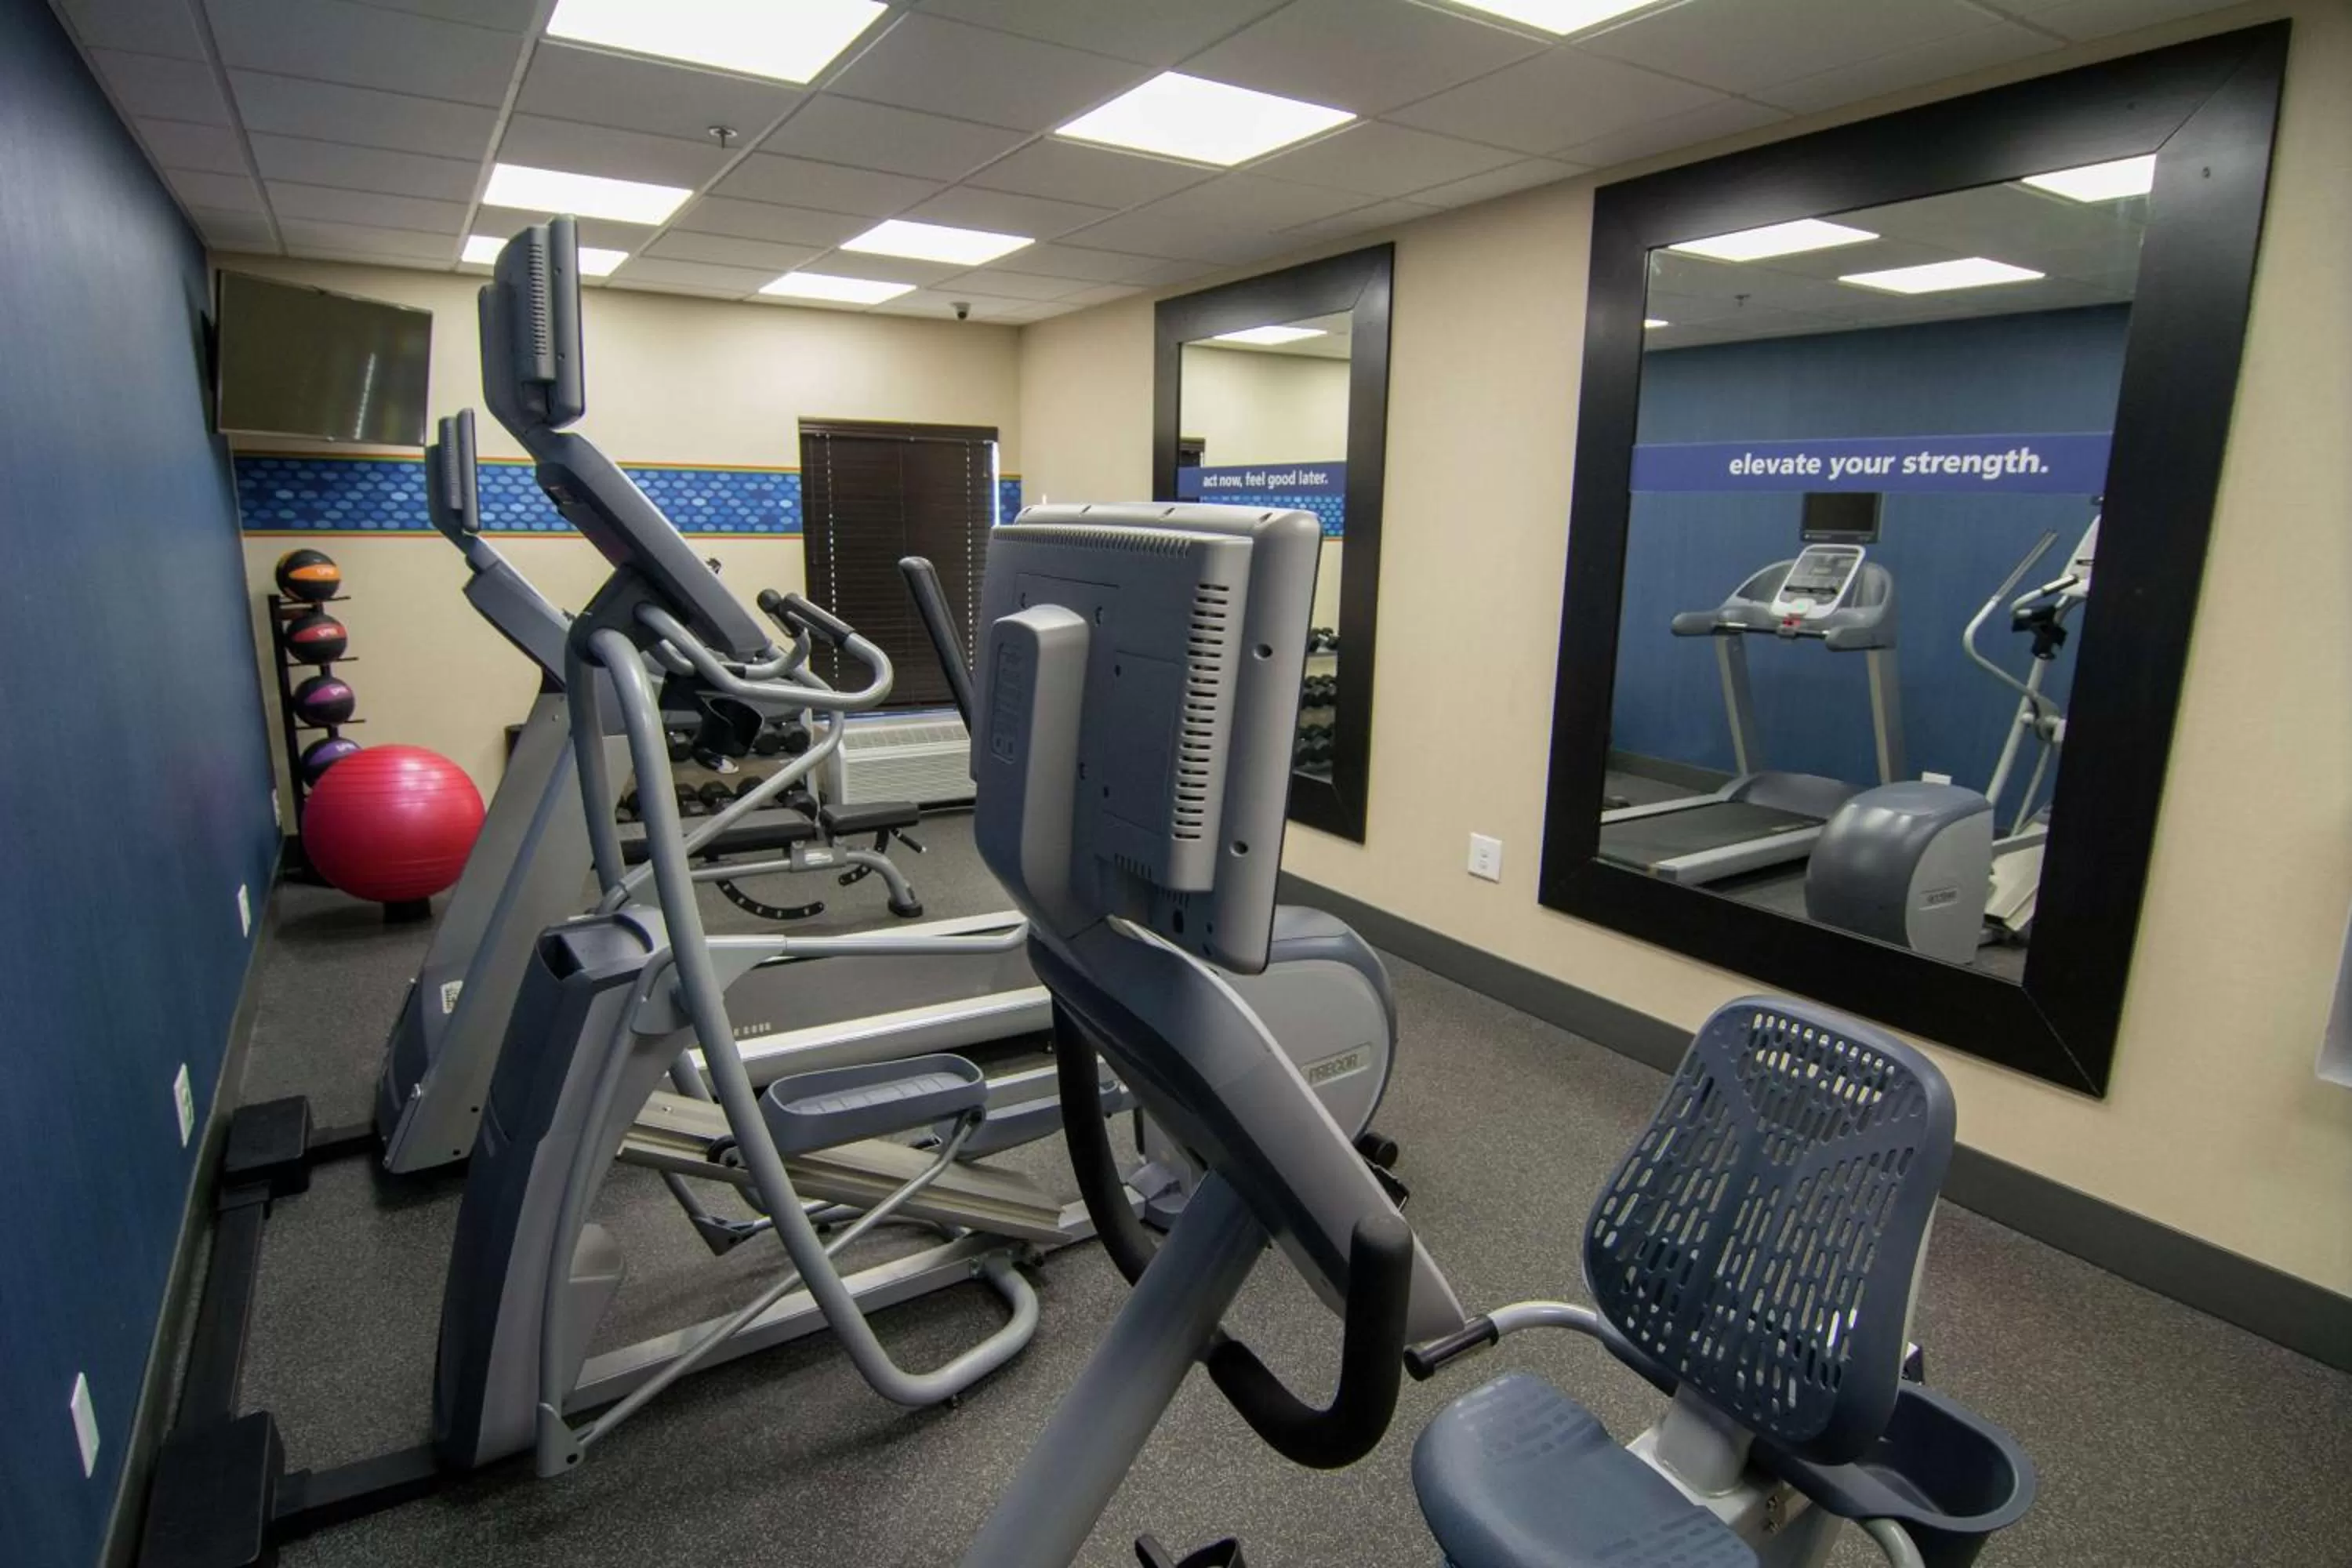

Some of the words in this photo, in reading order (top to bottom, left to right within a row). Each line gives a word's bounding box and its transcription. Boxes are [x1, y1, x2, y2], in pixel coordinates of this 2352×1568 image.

[1729, 452, 1822, 475] elevate
[1828, 456, 1896, 481] your
[1902, 447, 2049, 481] strength.
[1203, 473, 1218, 488] act
[1219, 474, 1243, 488] now,
[1245, 470, 1266, 487] feel
[1268, 470, 1296, 490] good
[1298, 470, 1329, 486] later.
